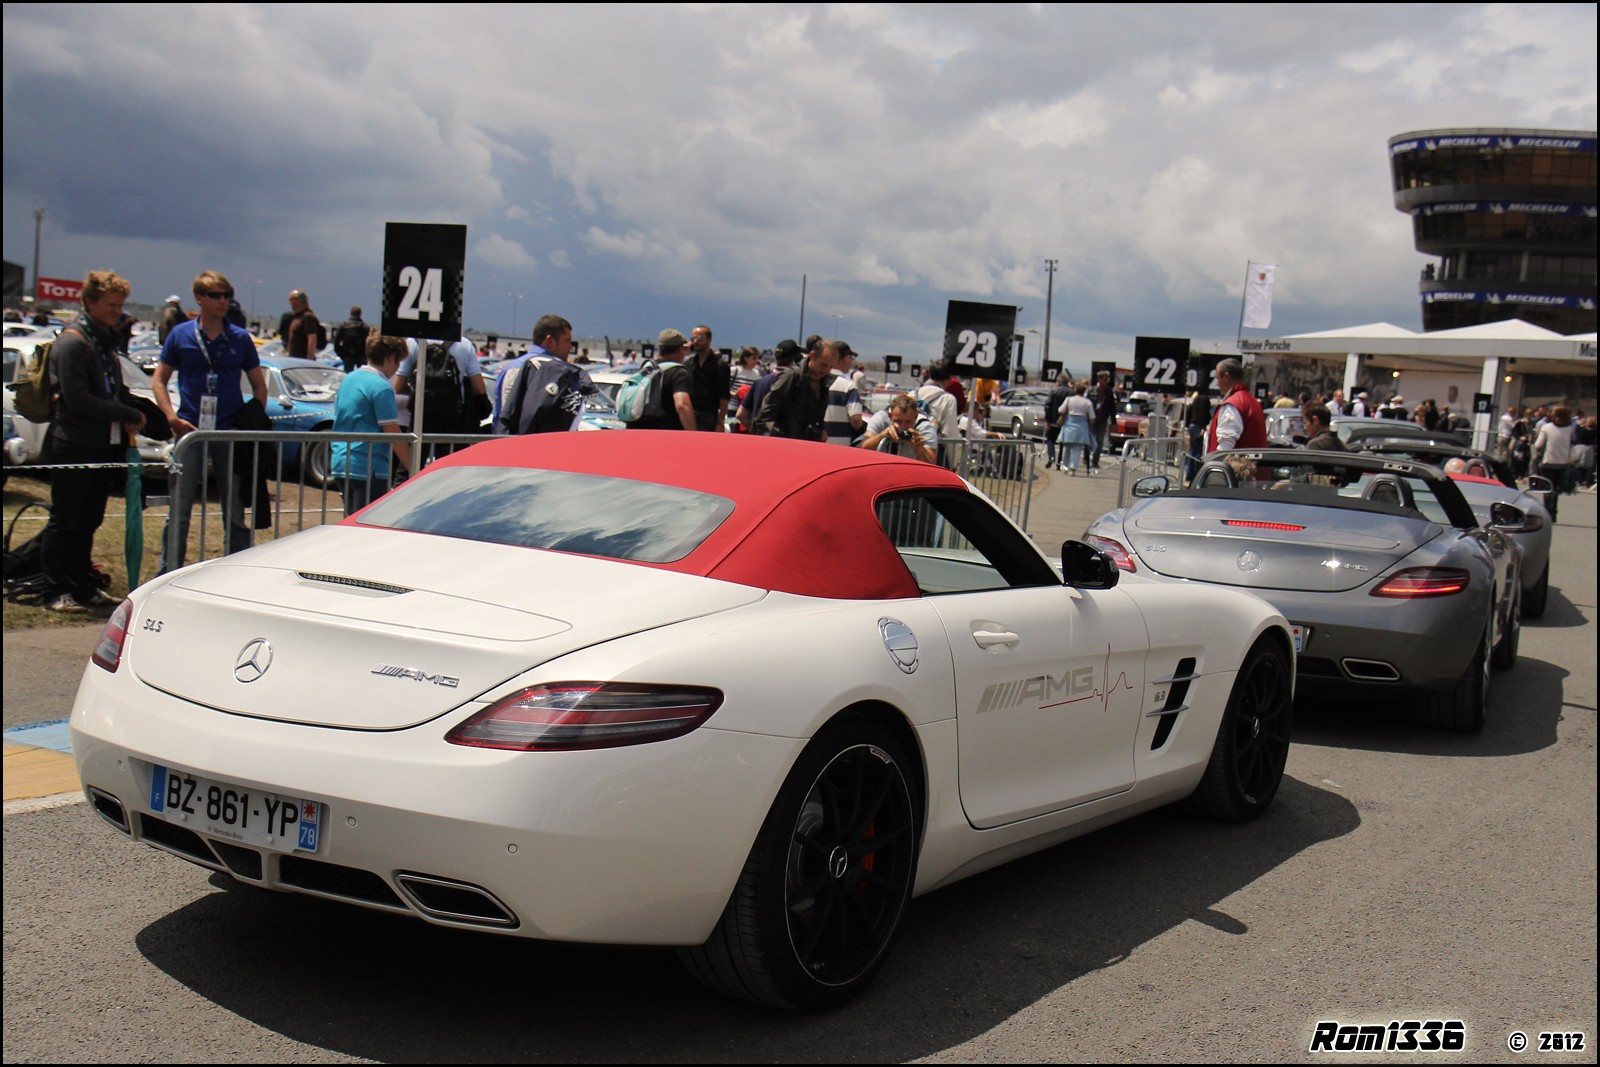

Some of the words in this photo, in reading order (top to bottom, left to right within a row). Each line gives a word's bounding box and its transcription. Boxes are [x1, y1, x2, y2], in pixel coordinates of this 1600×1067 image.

[1438, 138, 1489, 146] MICHELIN
[1517, 138, 1582, 148] MICHELIN
[1433, 203, 1478, 213] MICHELIN
[1508, 203, 1569, 213] MICHELIN
[397, 265, 444, 322] 24
[1434, 292, 1476, 301] MICHELIN
[1505, 293, 1566, 305] MICHELIN
[955, 329, 998, 368] 23
[1264, 339, 1291, 351] Porsche
[1144, 357, 1177, 385] 22
[1144, 543, 1166, 553] SLS
[143, 618, 164, 633] SLS
[398, 666, 460, 688] AMG
[1017, 666, 1094, 706] AMG
[155, 792, 161, 803] F
[166, 773, 299, 837] BZ-861-YP
[300, 825, 316, 846] 78
